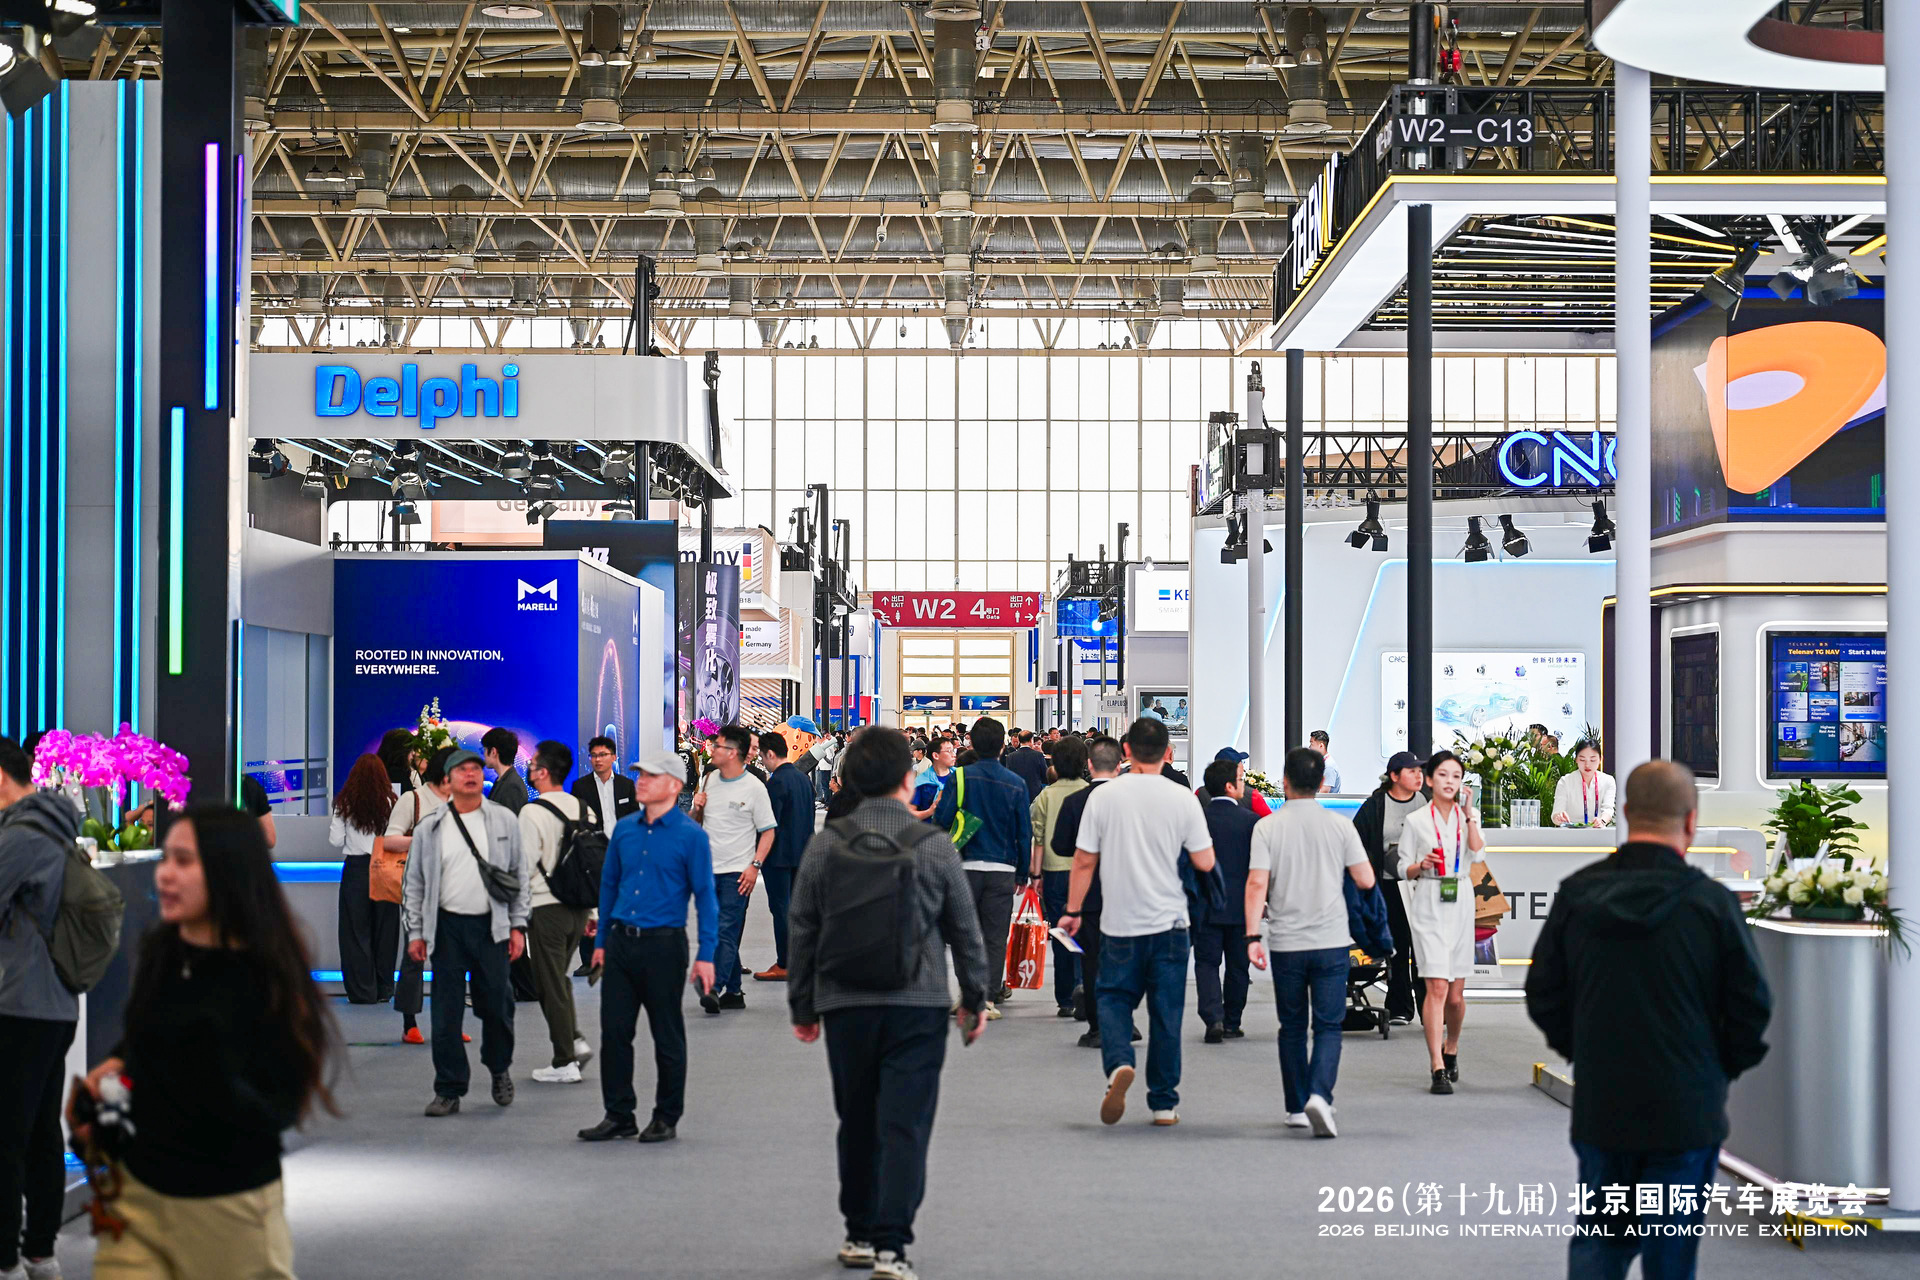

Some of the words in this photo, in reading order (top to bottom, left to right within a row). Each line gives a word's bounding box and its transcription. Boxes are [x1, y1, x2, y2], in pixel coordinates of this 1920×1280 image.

[315, 363, 520, 429] Delphi
[517, 603, 558, 611] MARELLI
[912, 598, 956, 619] W2
[969, 598, 987, 620] 4
[355, 650, 407, 660] ROOTED
[411, 650, 423, 660] IN
[426, 650, 504, 661] INNOVATION,
[355, 664, 440, 674] EVERYWHERE.
